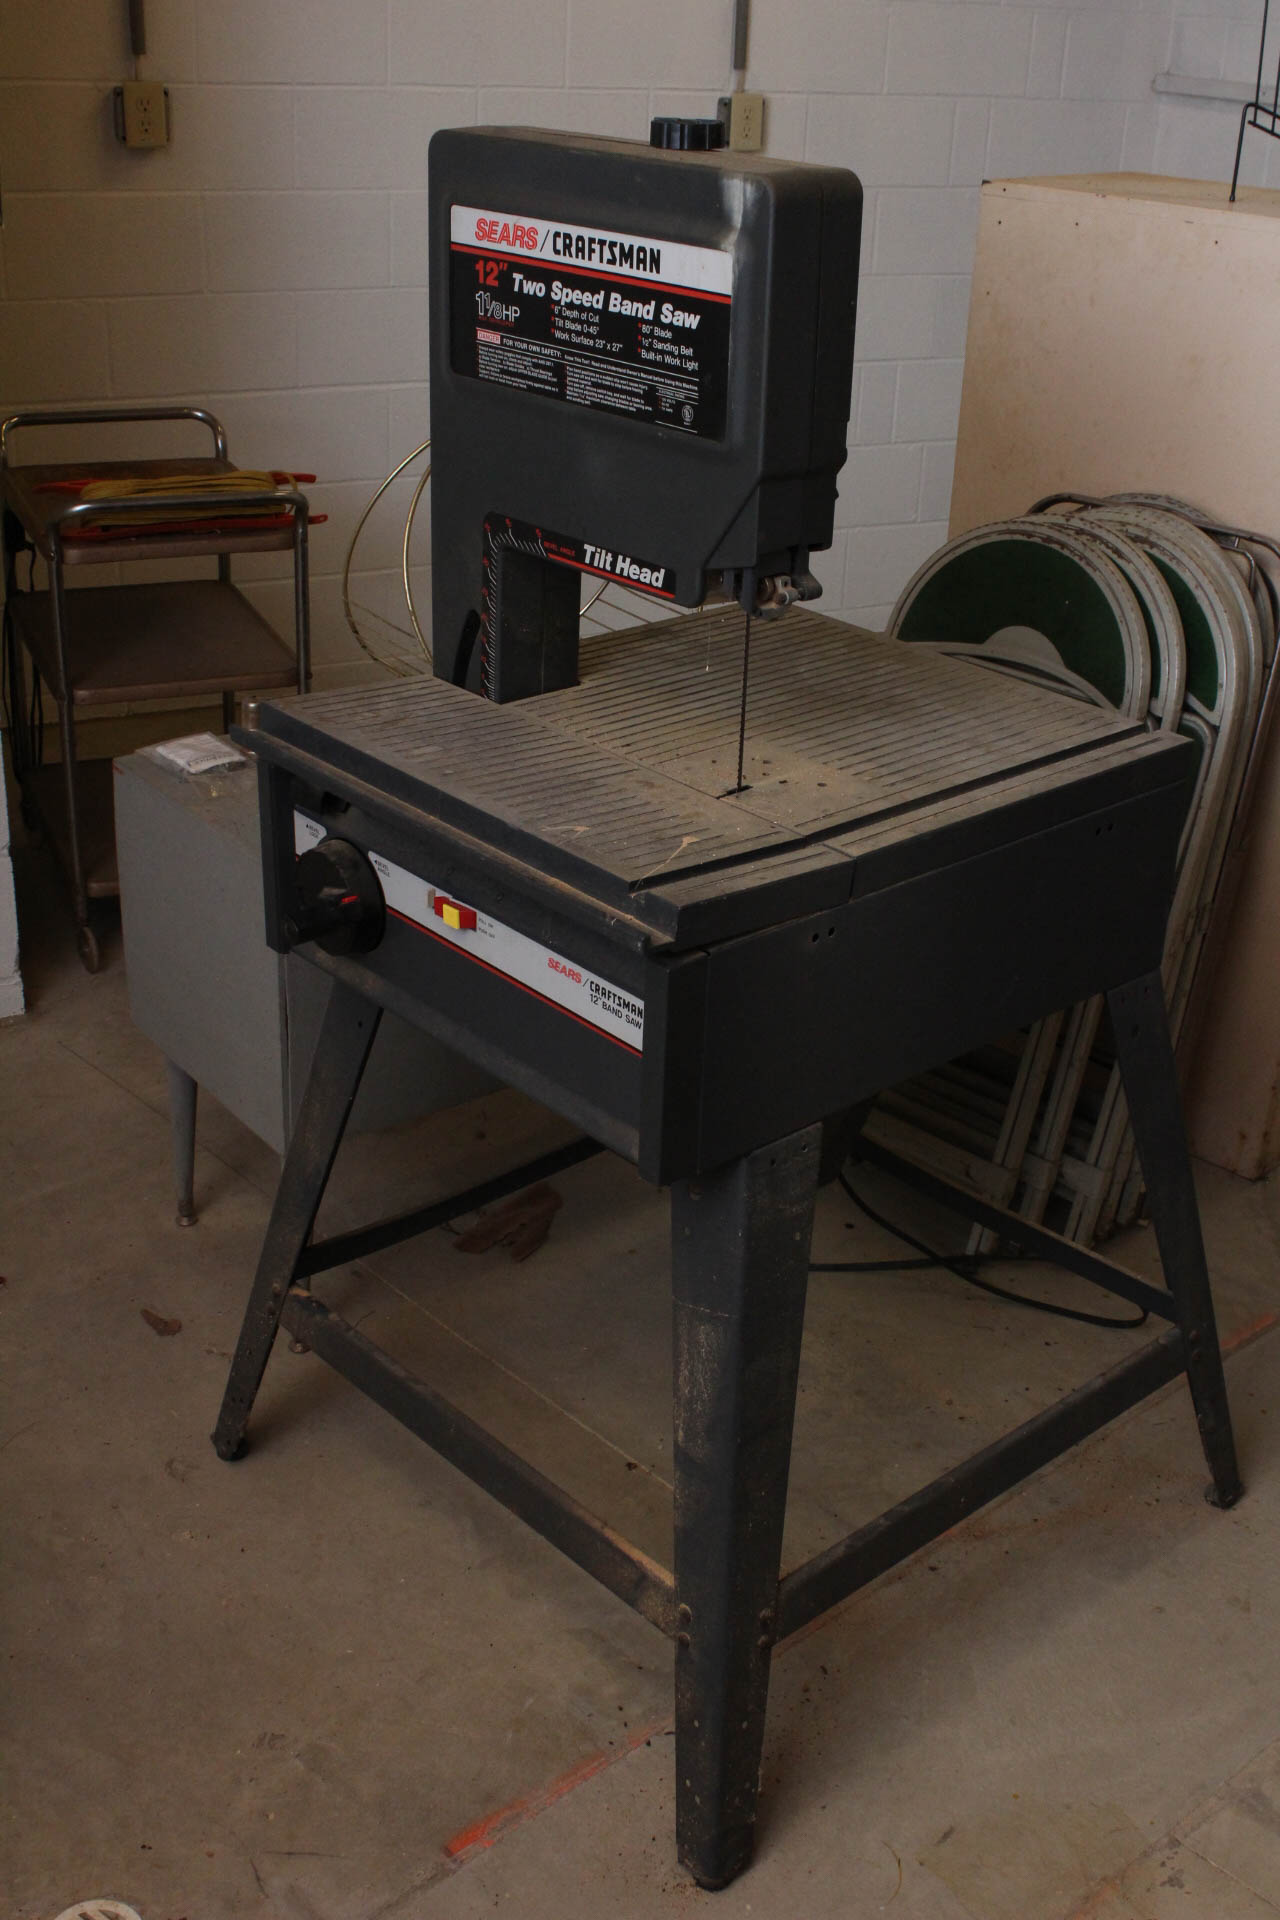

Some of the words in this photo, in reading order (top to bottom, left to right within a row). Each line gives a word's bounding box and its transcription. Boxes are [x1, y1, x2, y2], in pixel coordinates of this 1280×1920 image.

[553, 231, 661, 275] CRAFTSMAN
[475, 260, 508, 287] 12"
[513, 272, 546, 297] Two
[551, 281, 604, 310] Speed
[608, 292, 656, 320] Band
[660, 303, 701, 330] Saw
[554, 317, 564, 327] Tilt
[565, 320, 581, 332] Blade
[562, 307, 579, 319] Depth
[580, 311, 587, 321] of
[588, 312, 599, 323] Cut
[554, 329, 569, 341] Work
[571, 333, 594, 346] Surface
[595, 339, 606, 348] 23"
[612, 343, 623, 352] 27"
[653, 326, 672, 339] Blade
[503, 338, 513, 347] FOR
[514, 341, 528, 350] YOUR
[528, 344, 540, 353] OWN
[541, 347, 562, 358] SAFETY:
[641, 348, 662, 362] Built-in
[664, 353, 681, 367] Work
[682, 358, 699, 371] Light
[652, 339, 678, 355] Sanding
[680, 345, 693, 357] Belt
[583, 543, 613, 571] Tilt
[615, 555, 666, 588] Head
[547, 957, 582, 984] SEARS
[589, 980, 643, 1019] CRAFTSMAN
[590, 993, 602, 1005] 12"
[602, 1001, 623, 1019] BAND
[625, 1014, 642, 1030] SAW
